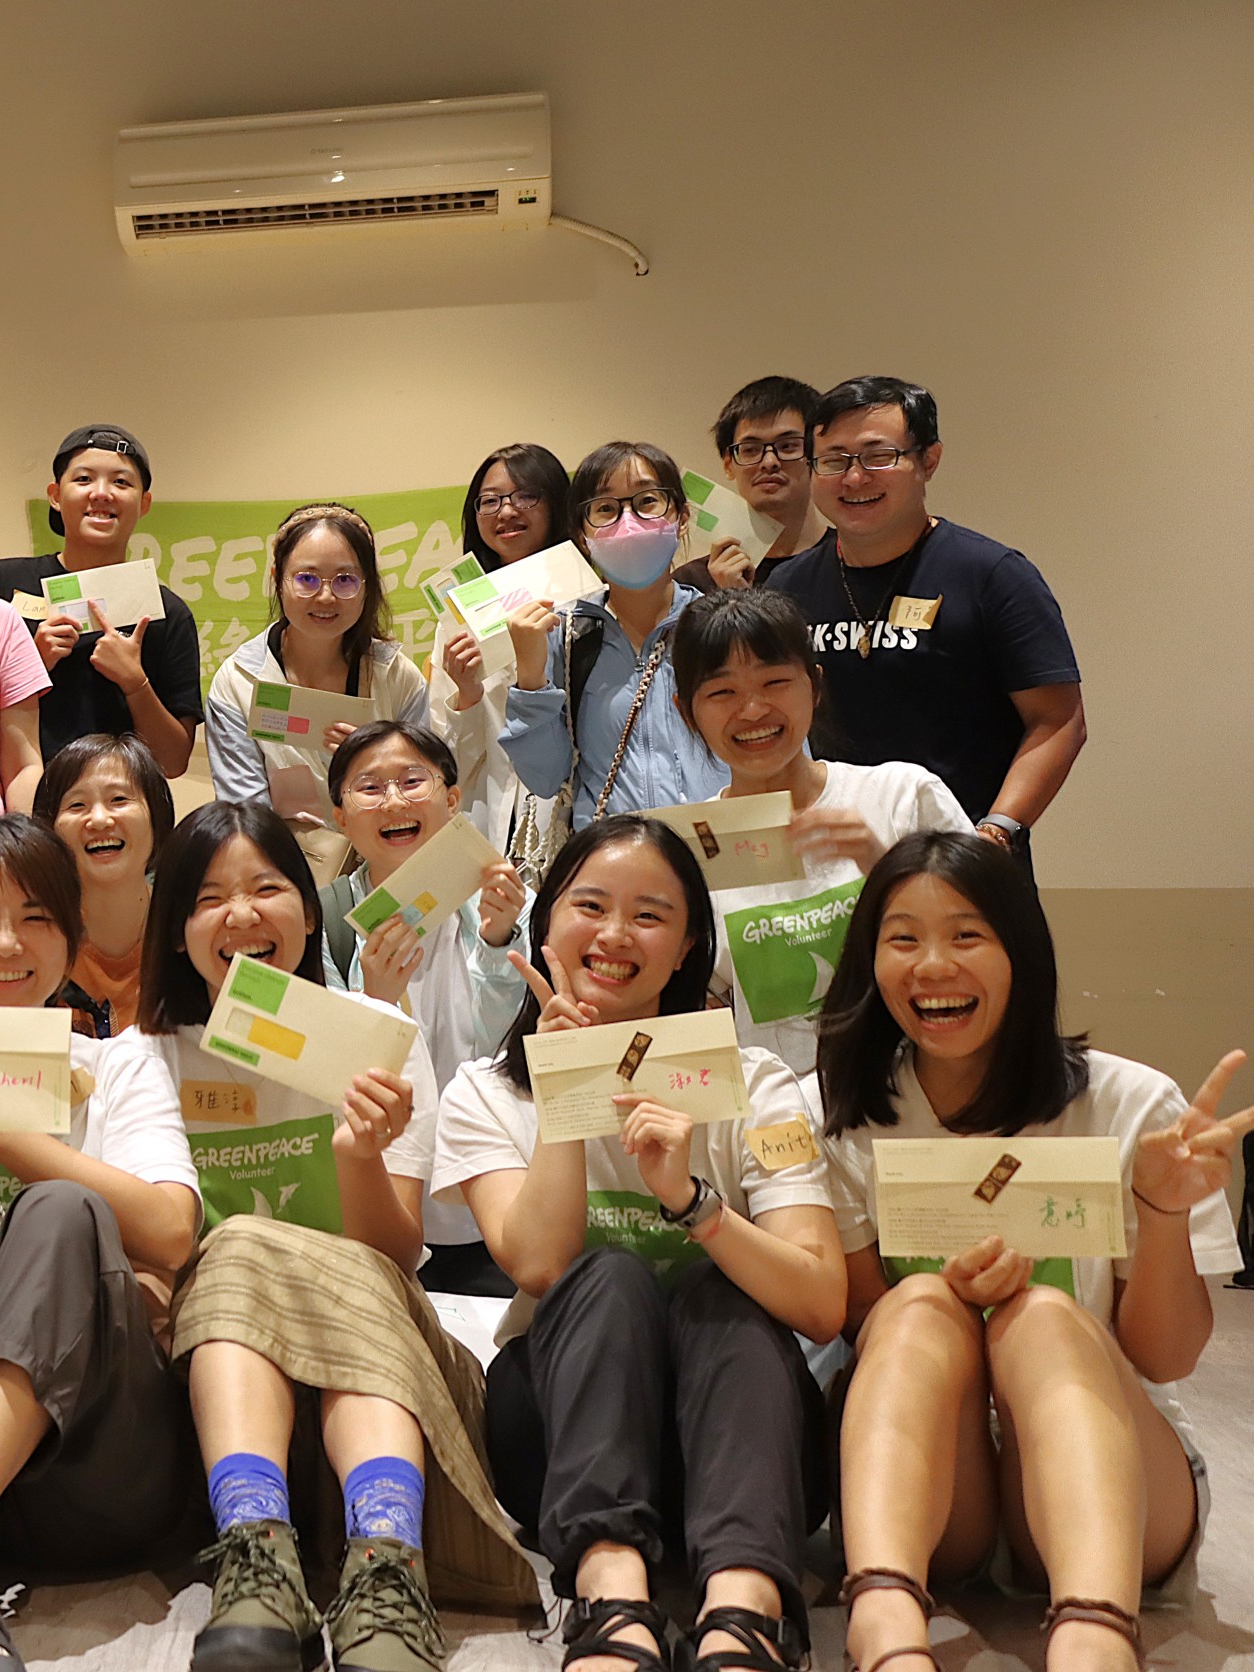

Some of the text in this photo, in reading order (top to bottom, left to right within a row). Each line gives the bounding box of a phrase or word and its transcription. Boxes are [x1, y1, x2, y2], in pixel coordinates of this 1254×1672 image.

[742, 895, 861, 944] GREENPEAC
[785, 928, 833, 946] Volunteer
[192, 1133, 319, 1170] GREENPEACE
[761, 1132, 812, 1160] Anit
[230, 1166, 275, 1181] Volunteer
